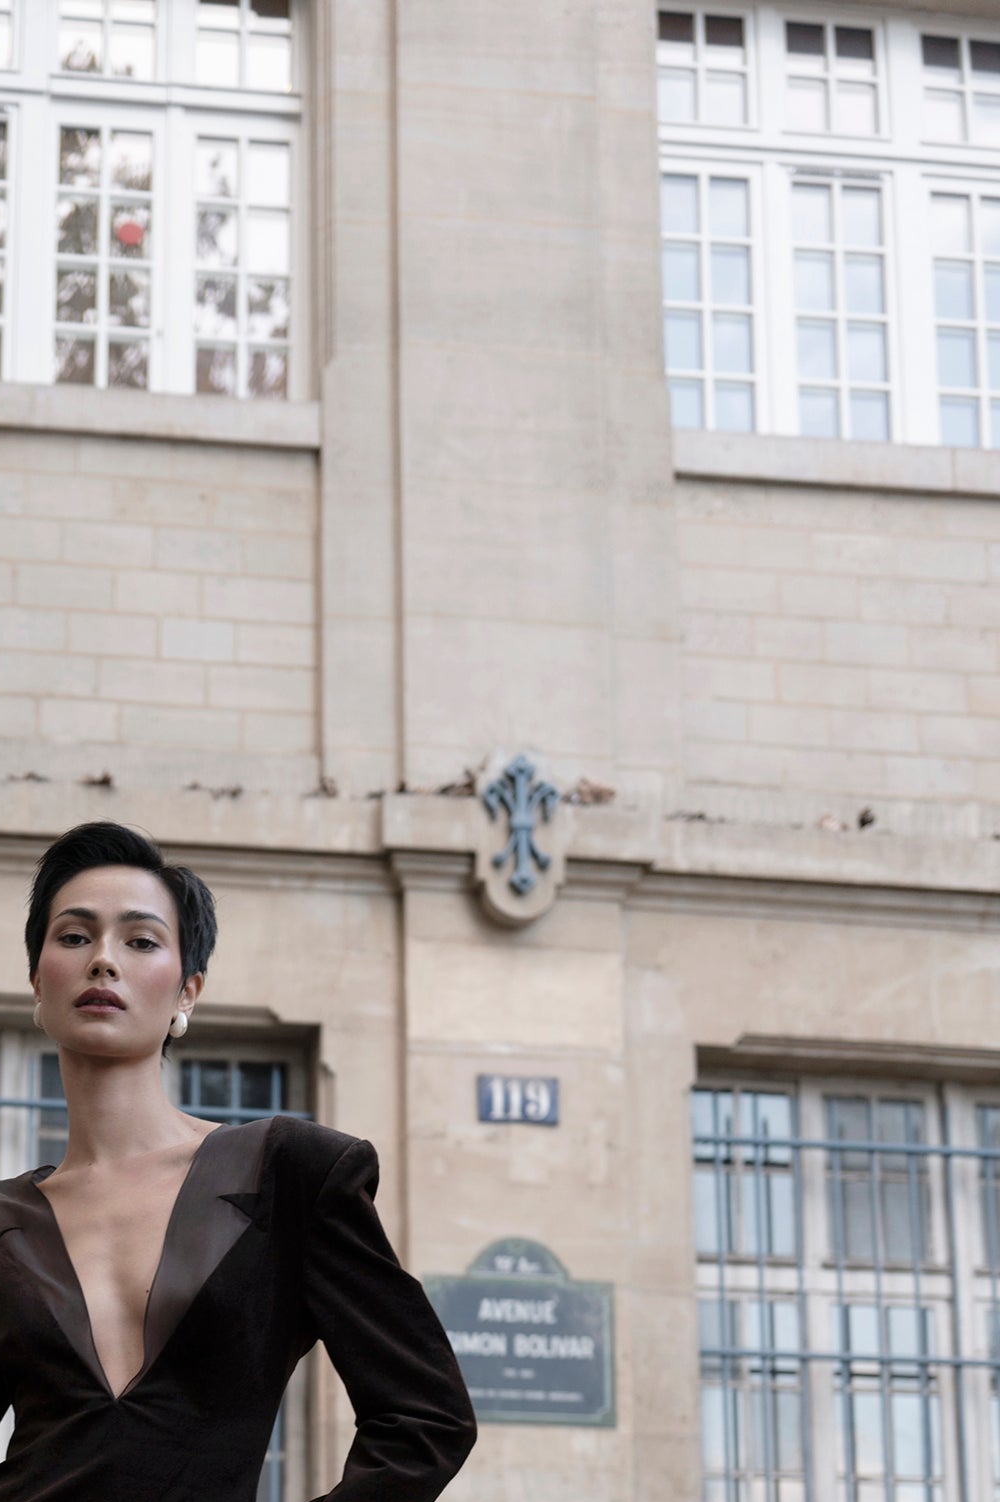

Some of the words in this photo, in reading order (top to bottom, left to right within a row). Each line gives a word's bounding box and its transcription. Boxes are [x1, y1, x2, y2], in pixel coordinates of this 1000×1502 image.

[488, 1077, 551, 1121] 119
[477, 1298, 557, 1324] AVENUE
[513, 1333, 595, 1360] BOLIVAR
